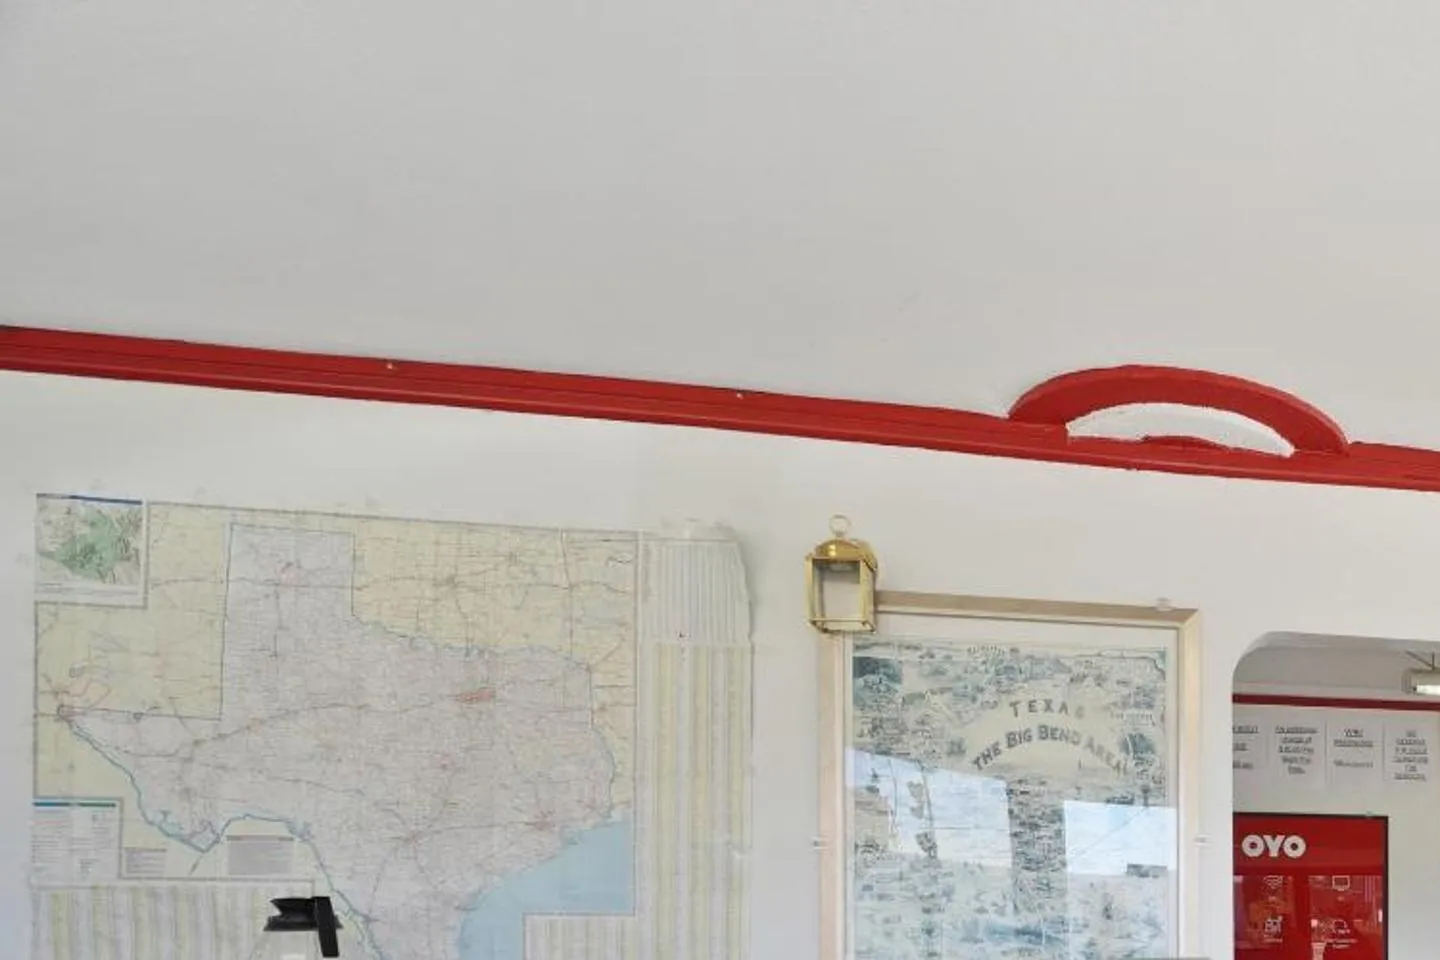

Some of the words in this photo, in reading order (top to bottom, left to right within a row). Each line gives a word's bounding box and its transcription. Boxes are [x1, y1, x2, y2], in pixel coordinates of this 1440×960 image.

[1009, 698, 1085, 719] TEXAS
[972, 741, 1001, 771] THE
[1007, 727, 1033, 749] BIG
[1038, 724, 1081, 745] BEND
[1241, 834, 1307, 859] OYO
